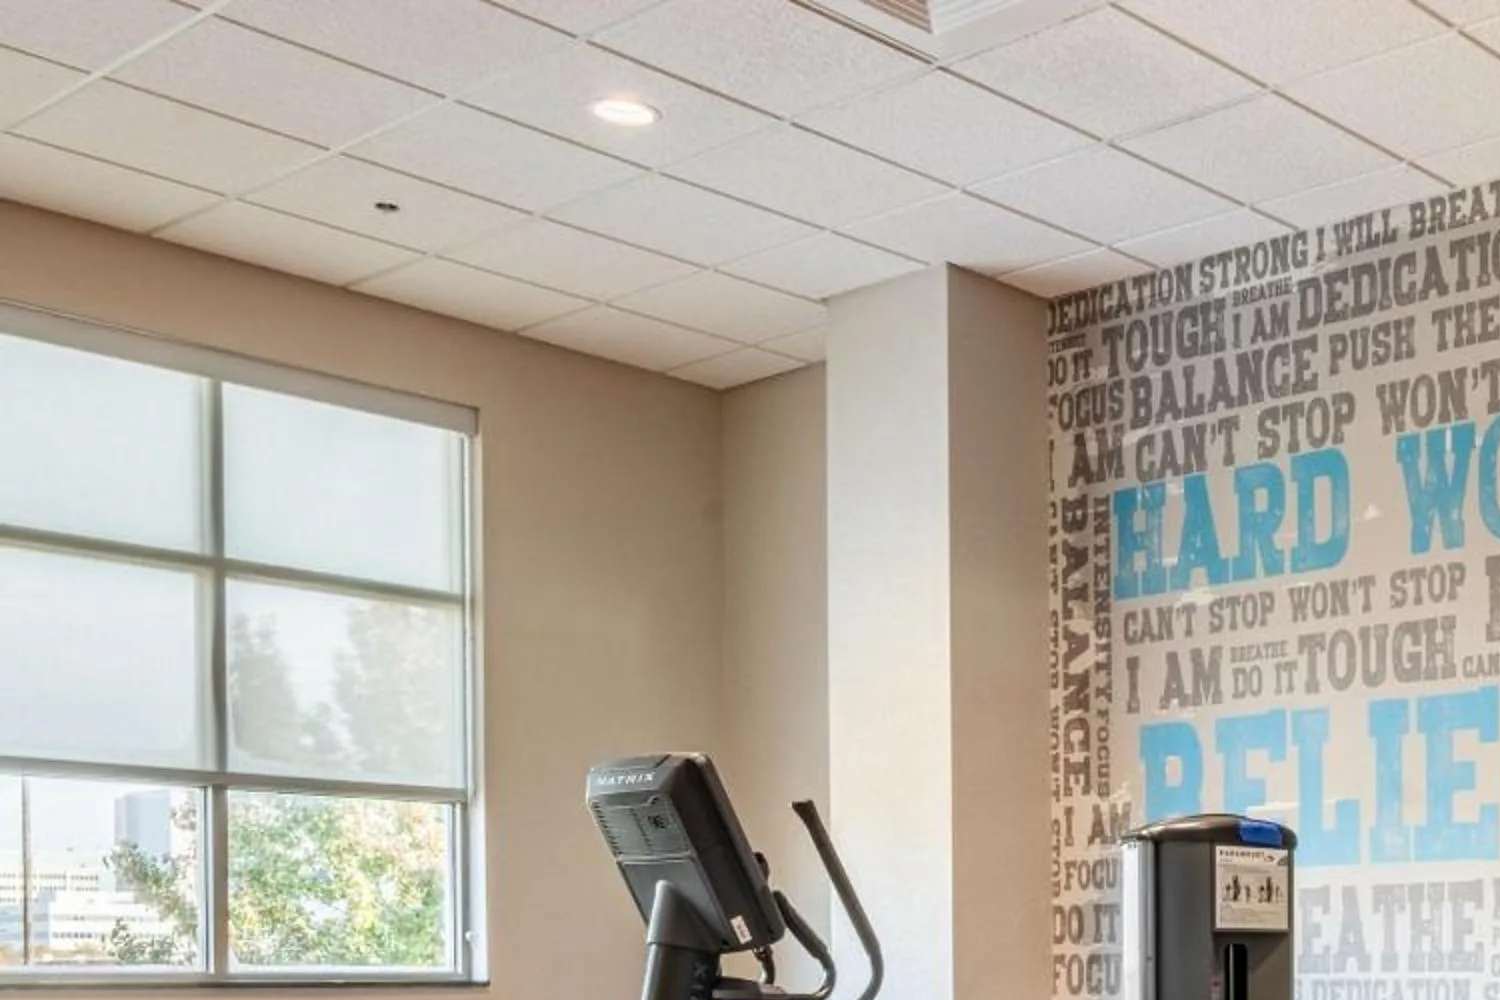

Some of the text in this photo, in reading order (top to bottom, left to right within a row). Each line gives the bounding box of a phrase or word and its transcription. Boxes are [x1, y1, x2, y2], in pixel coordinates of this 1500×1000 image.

[1200, 231, 1308, 295] STRONG
[1334, 208, 1397, 257] WILL
[1102, 298, 1226, 378] TOUGH
[1251, 301, 1291, 343] AM
[1131, 334, 1318, 430] BALANCE
[1328, 316, 1415, 376] PUSH
[1432, 296, 1500, 351] THE
[1136, 416, 1239, 483] CAN'T
[1257, 391, 1356, 460] STOP
[1112, 447, 1349, 601] HARD
[1124, 601, 1196, 646] CAN'T
[1209, 591, 1274, 633] STOP
[1288, 575, 1375, 622] WON'T
[1390, 561, 1465, 609] STOP
[1160, 645, 1223, 710] AM
[1232, 668, 1262, 699] DO
[1274, 661, 1297, 695] IT
[1298, 615, 1456, 693] TOUGH
